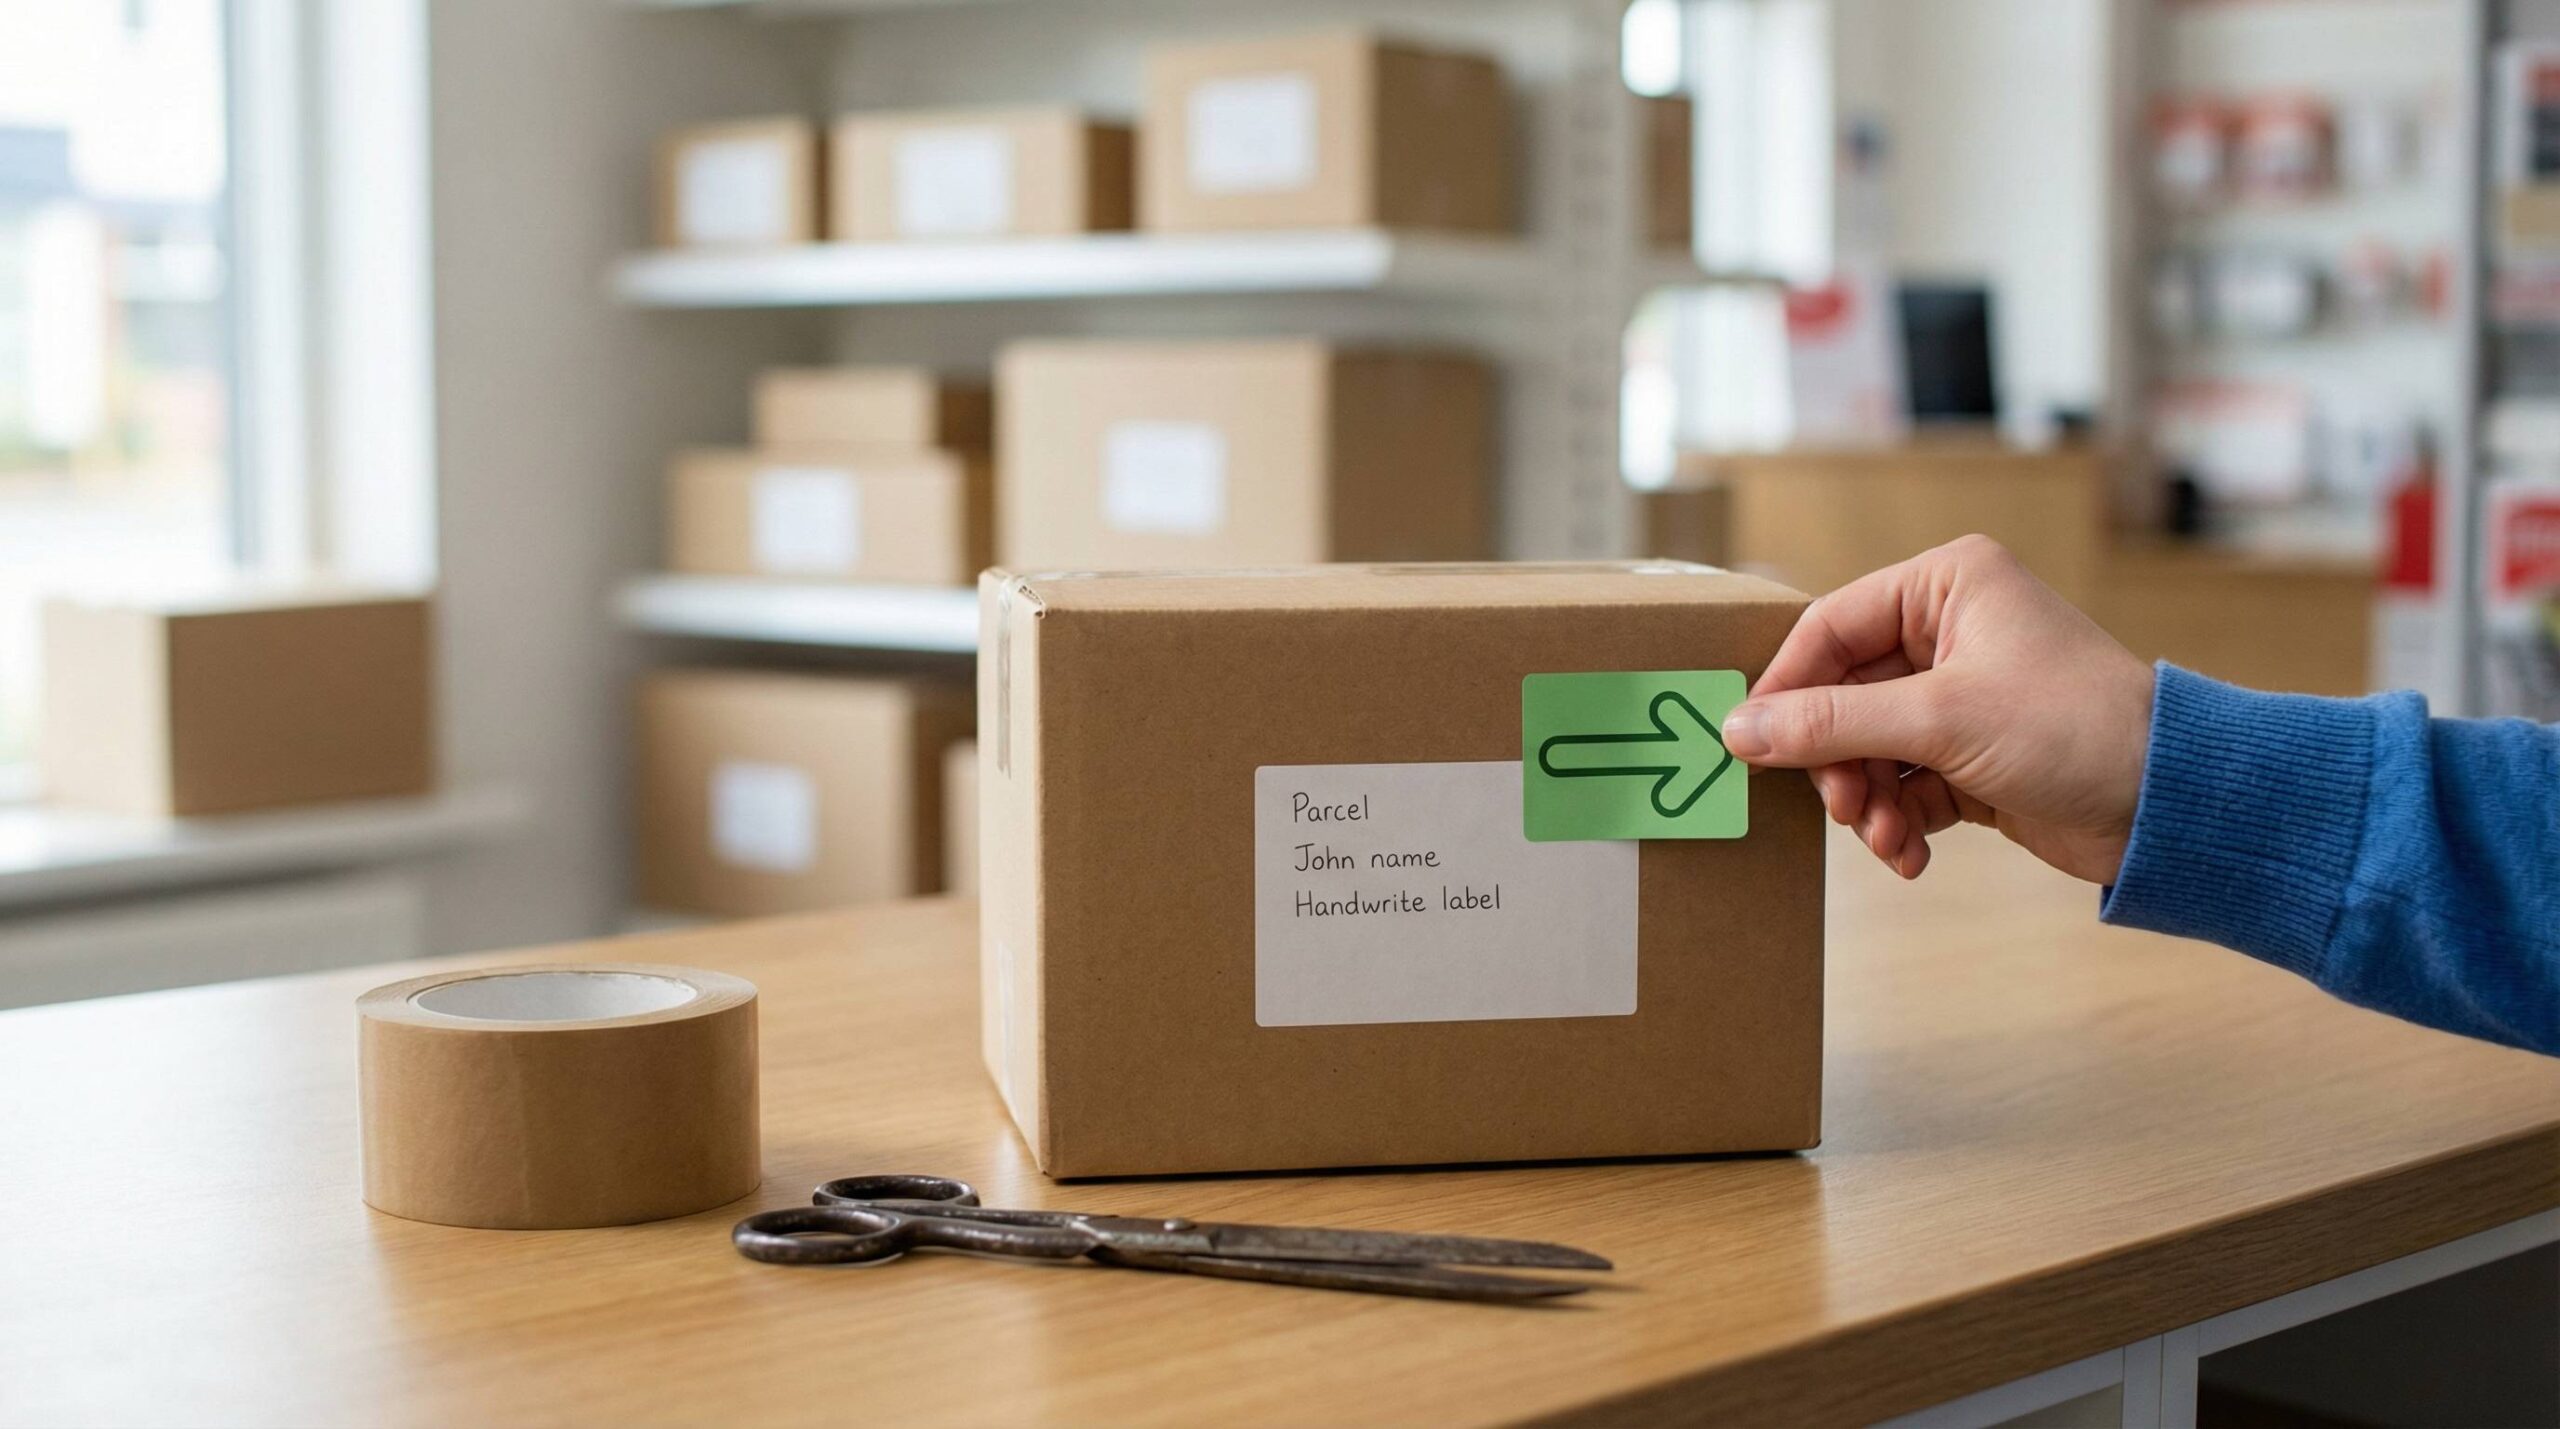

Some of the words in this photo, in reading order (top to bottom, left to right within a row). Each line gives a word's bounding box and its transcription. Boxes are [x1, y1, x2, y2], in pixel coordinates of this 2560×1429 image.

[1292, 791, 1369, 824] Parcel
[1294, 842, 1355, 872] John
[1371, 850, 1441, 869] name
[1295, 889, 1427, 918] Handwrite
[1442, 883, 1501, 911] label
